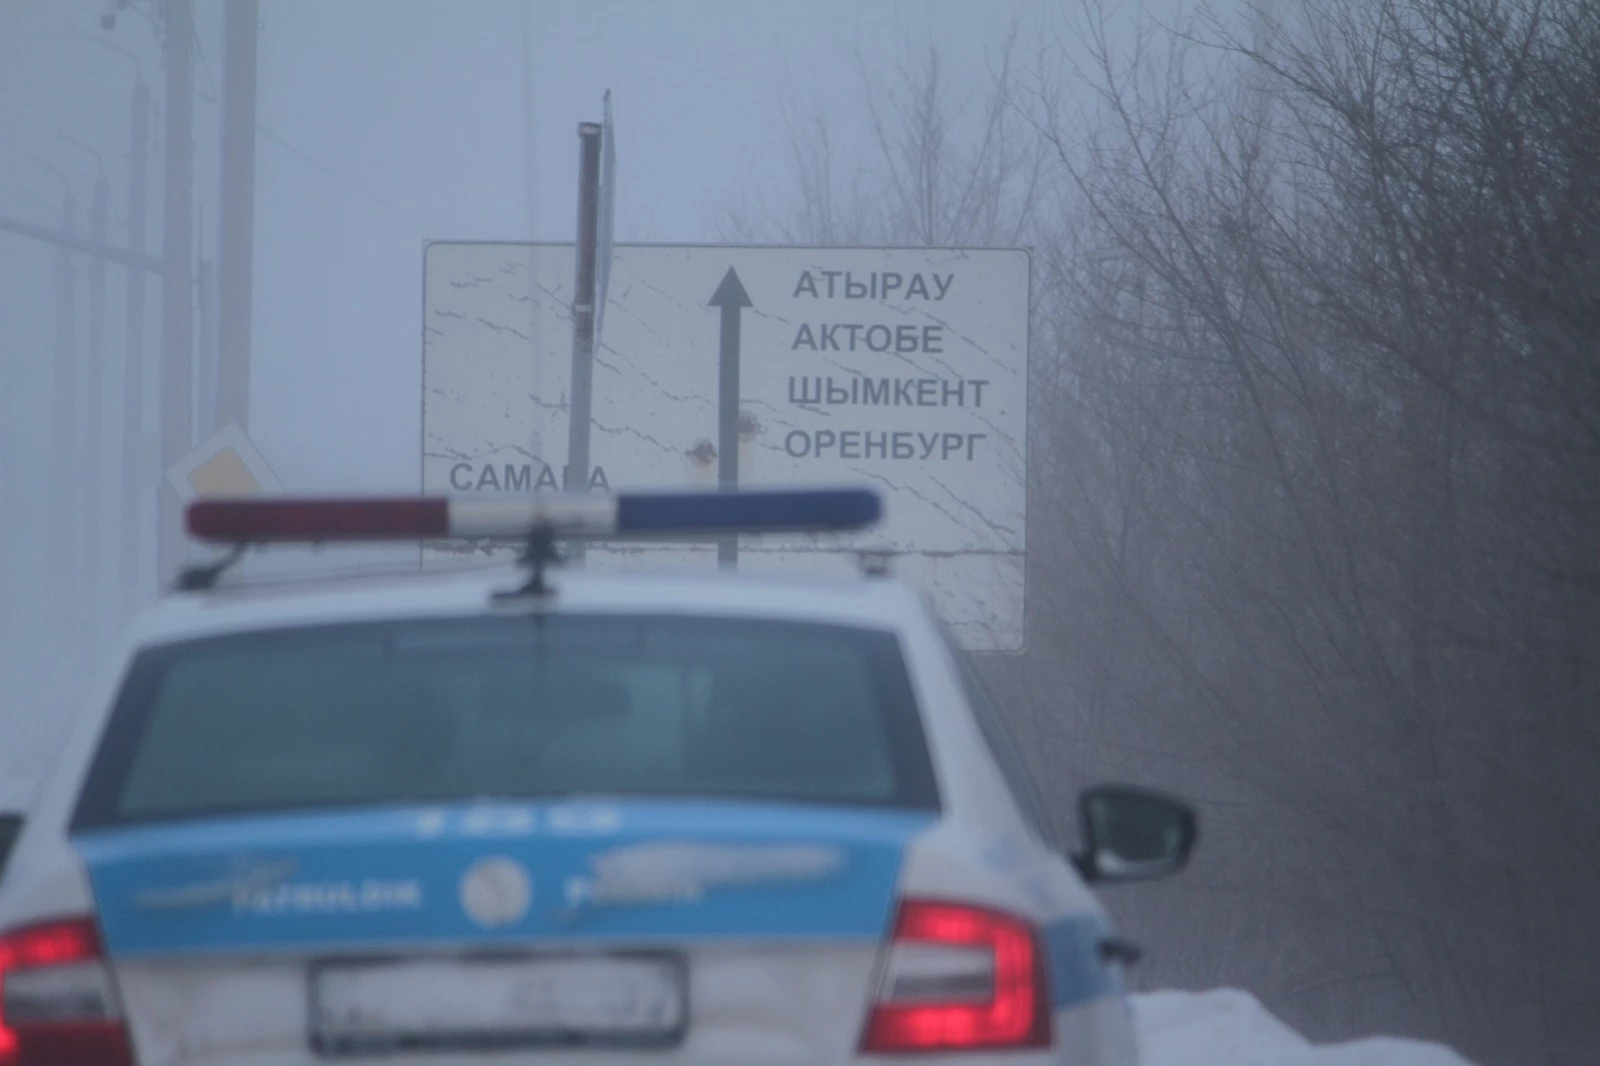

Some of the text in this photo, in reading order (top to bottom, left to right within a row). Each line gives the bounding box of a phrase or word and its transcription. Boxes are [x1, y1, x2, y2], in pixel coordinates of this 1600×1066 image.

[793, 270, 955, 301] АТЫРАУ
[791, 322, 945, 354] АКТОБЕ
[788, 375, 991, 408] ШЫМКЕНТ
[784, 428, 987, 462] ОРЕНБУРГ
[450, 462, 611, 493] САМАА
